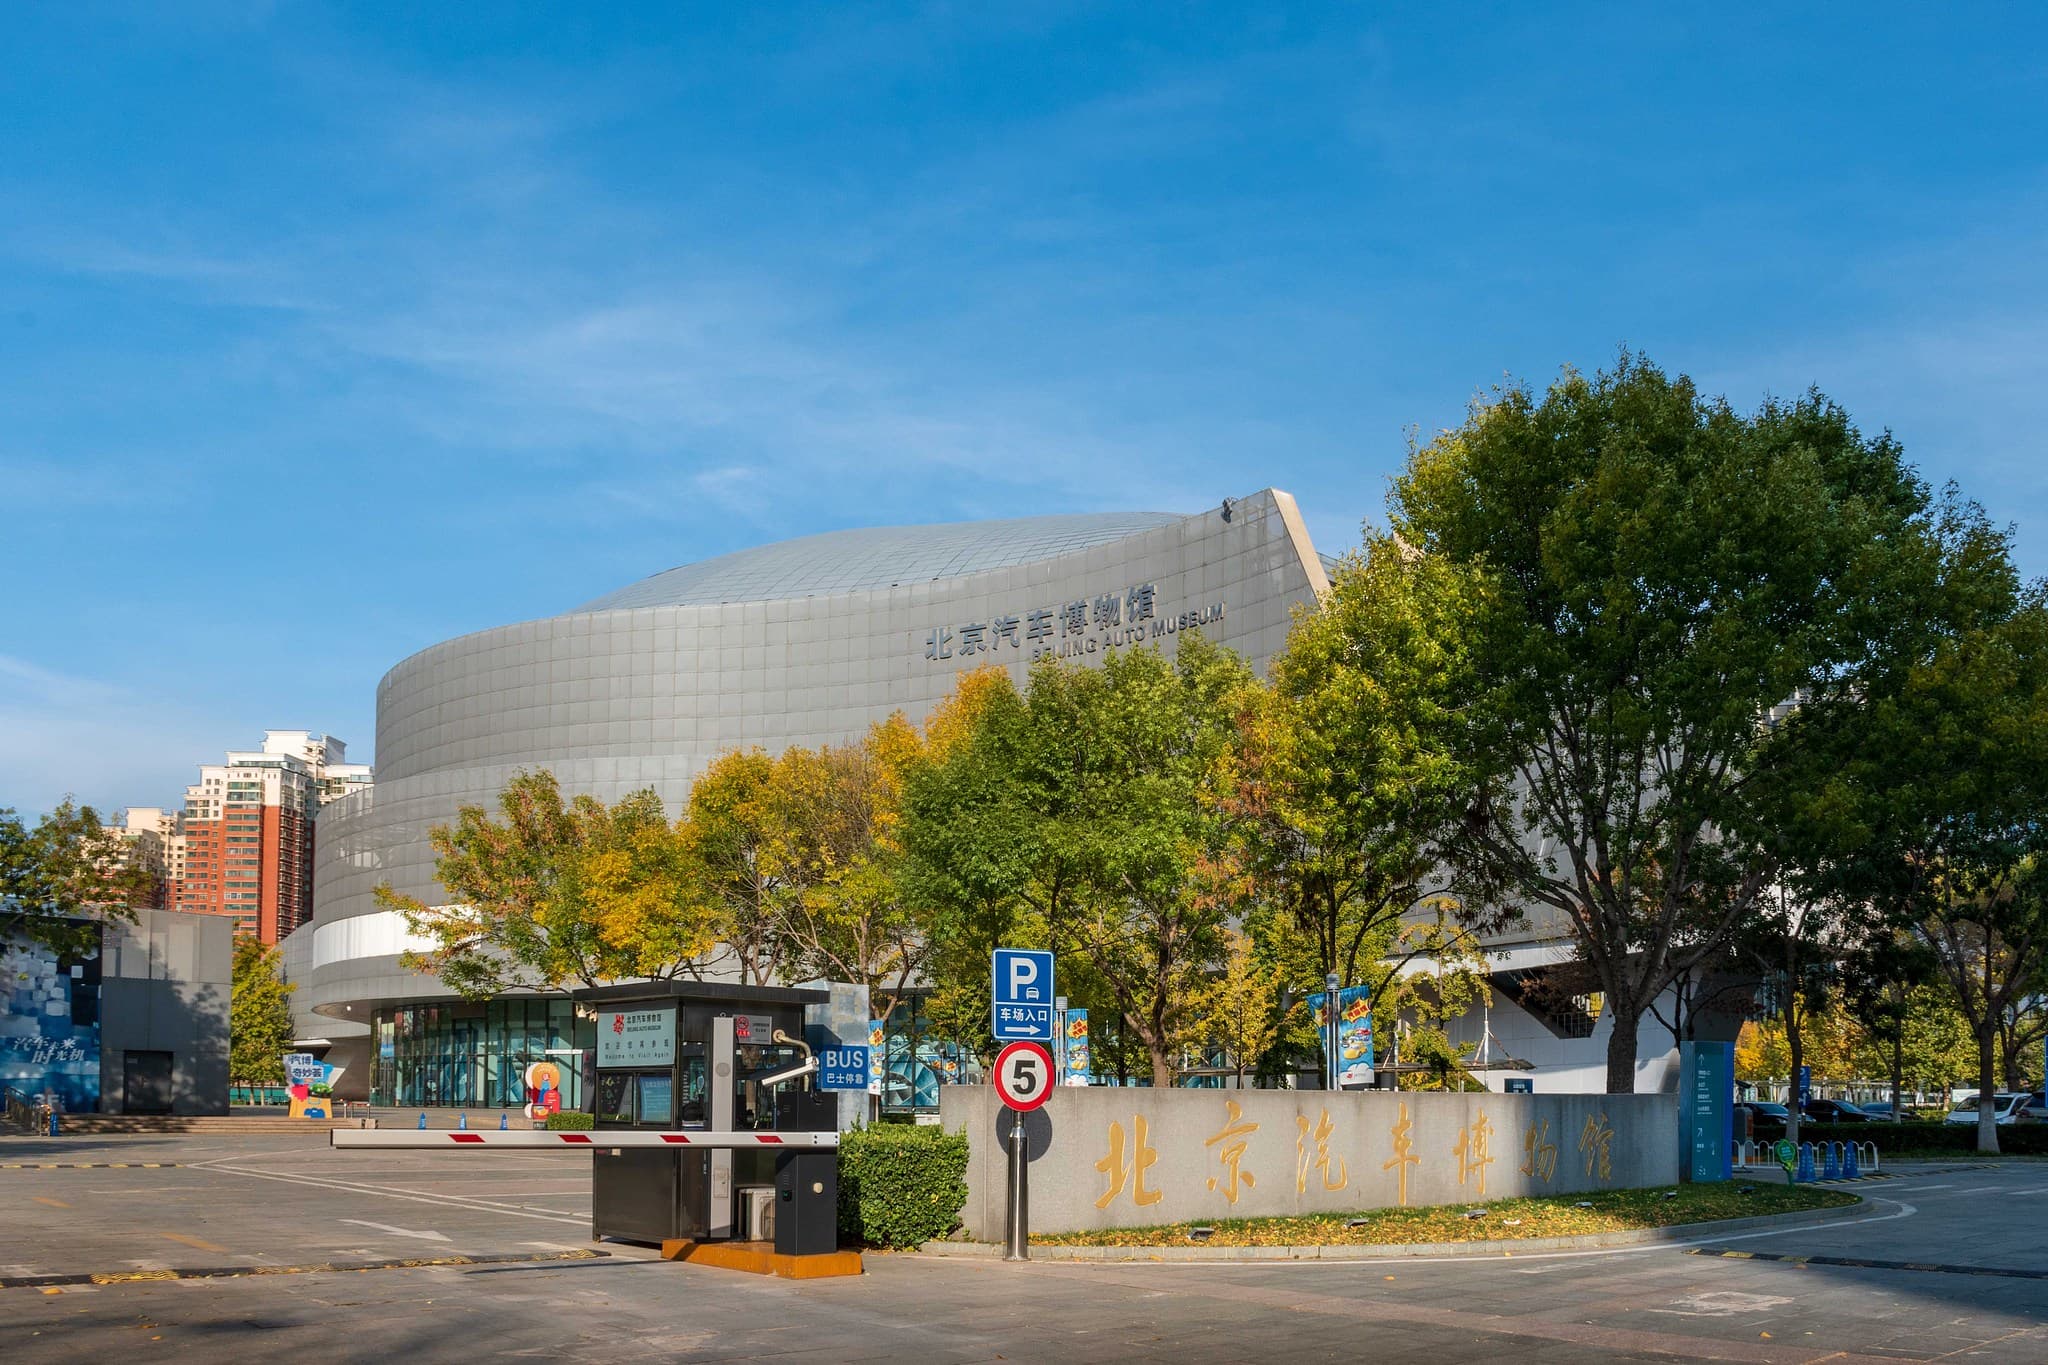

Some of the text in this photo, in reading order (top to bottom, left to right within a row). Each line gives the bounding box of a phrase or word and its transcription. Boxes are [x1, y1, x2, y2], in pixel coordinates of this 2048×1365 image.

[925, 583, 1157, 661] 北京汽车博物馆
[1102, 625, 1145, 651] AUTO
[1152, 601, 1226, 638] MUSEUM
[1009, 956, 1038, 1000] P
[1000, 1007, 1047, 1022] 车场入口
[31, 1047, 86, 1064] 时光机
[826, 1050, 864, 1068] BUS
[826, 1072, 864, 1085] 巴士停靠
[1012, 1059, 1037, 1095] 5
[1095, 1100, 1615, 1209] 北京汽车博物馆
